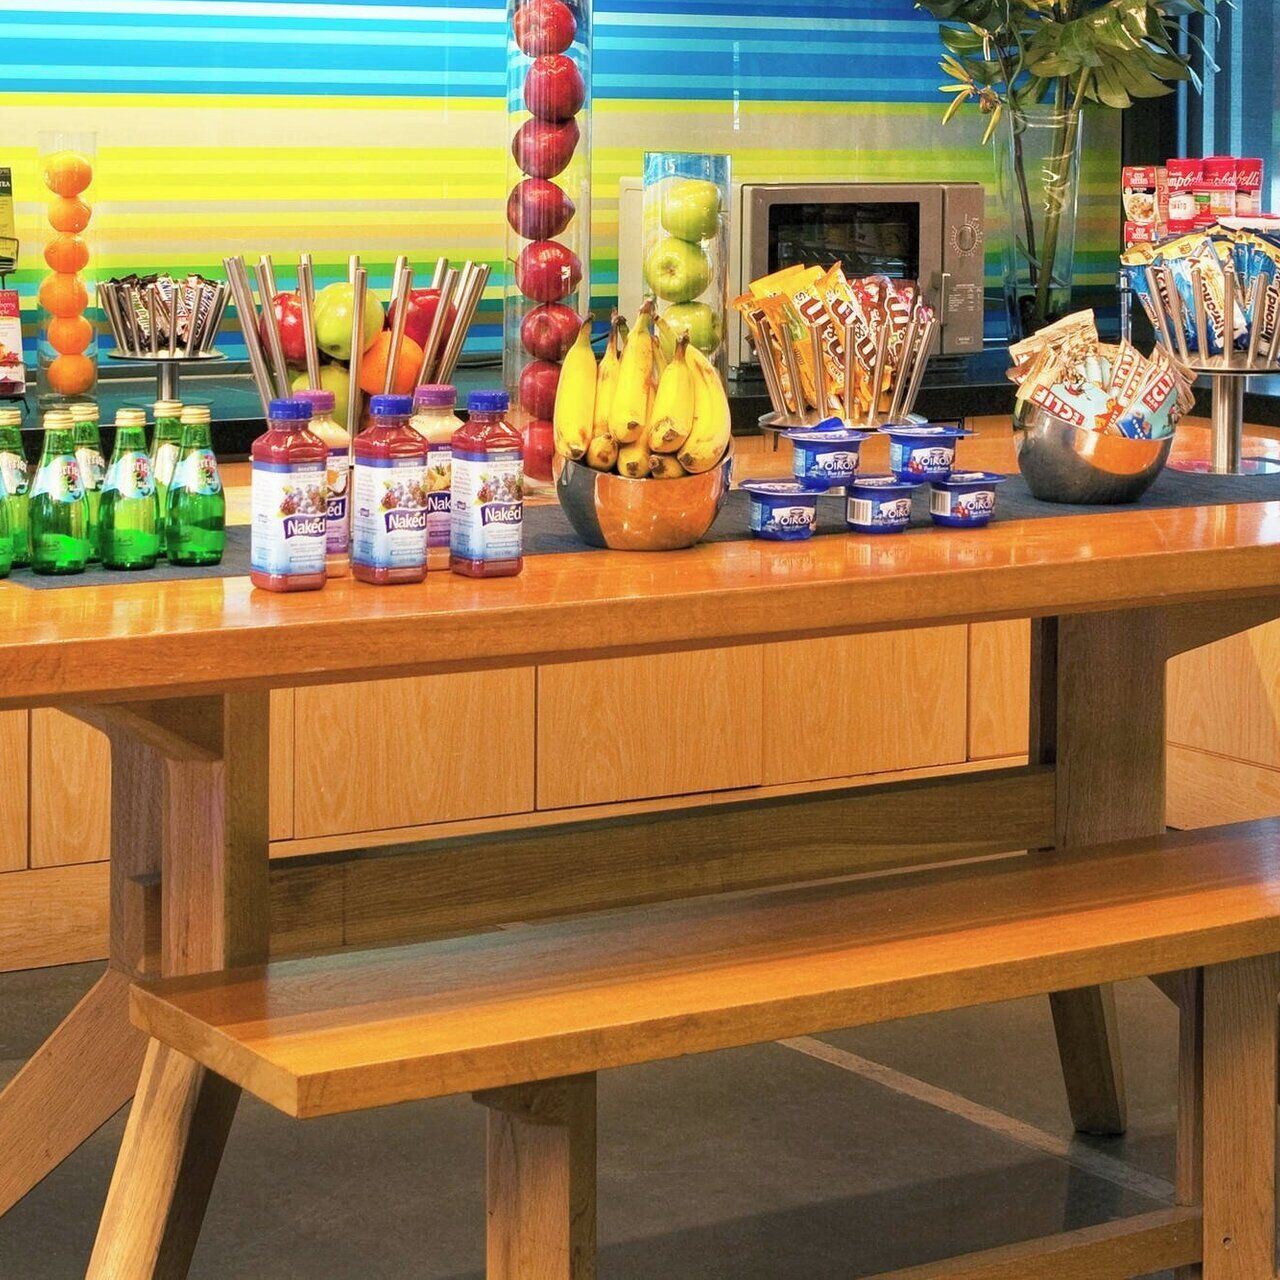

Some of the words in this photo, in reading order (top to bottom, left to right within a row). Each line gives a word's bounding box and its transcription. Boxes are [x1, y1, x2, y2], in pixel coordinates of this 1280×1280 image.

[387, 511, 427, 530] Naked
[484, 503, 522, 522] Naked
[287, 517, 326, 537] Naked
